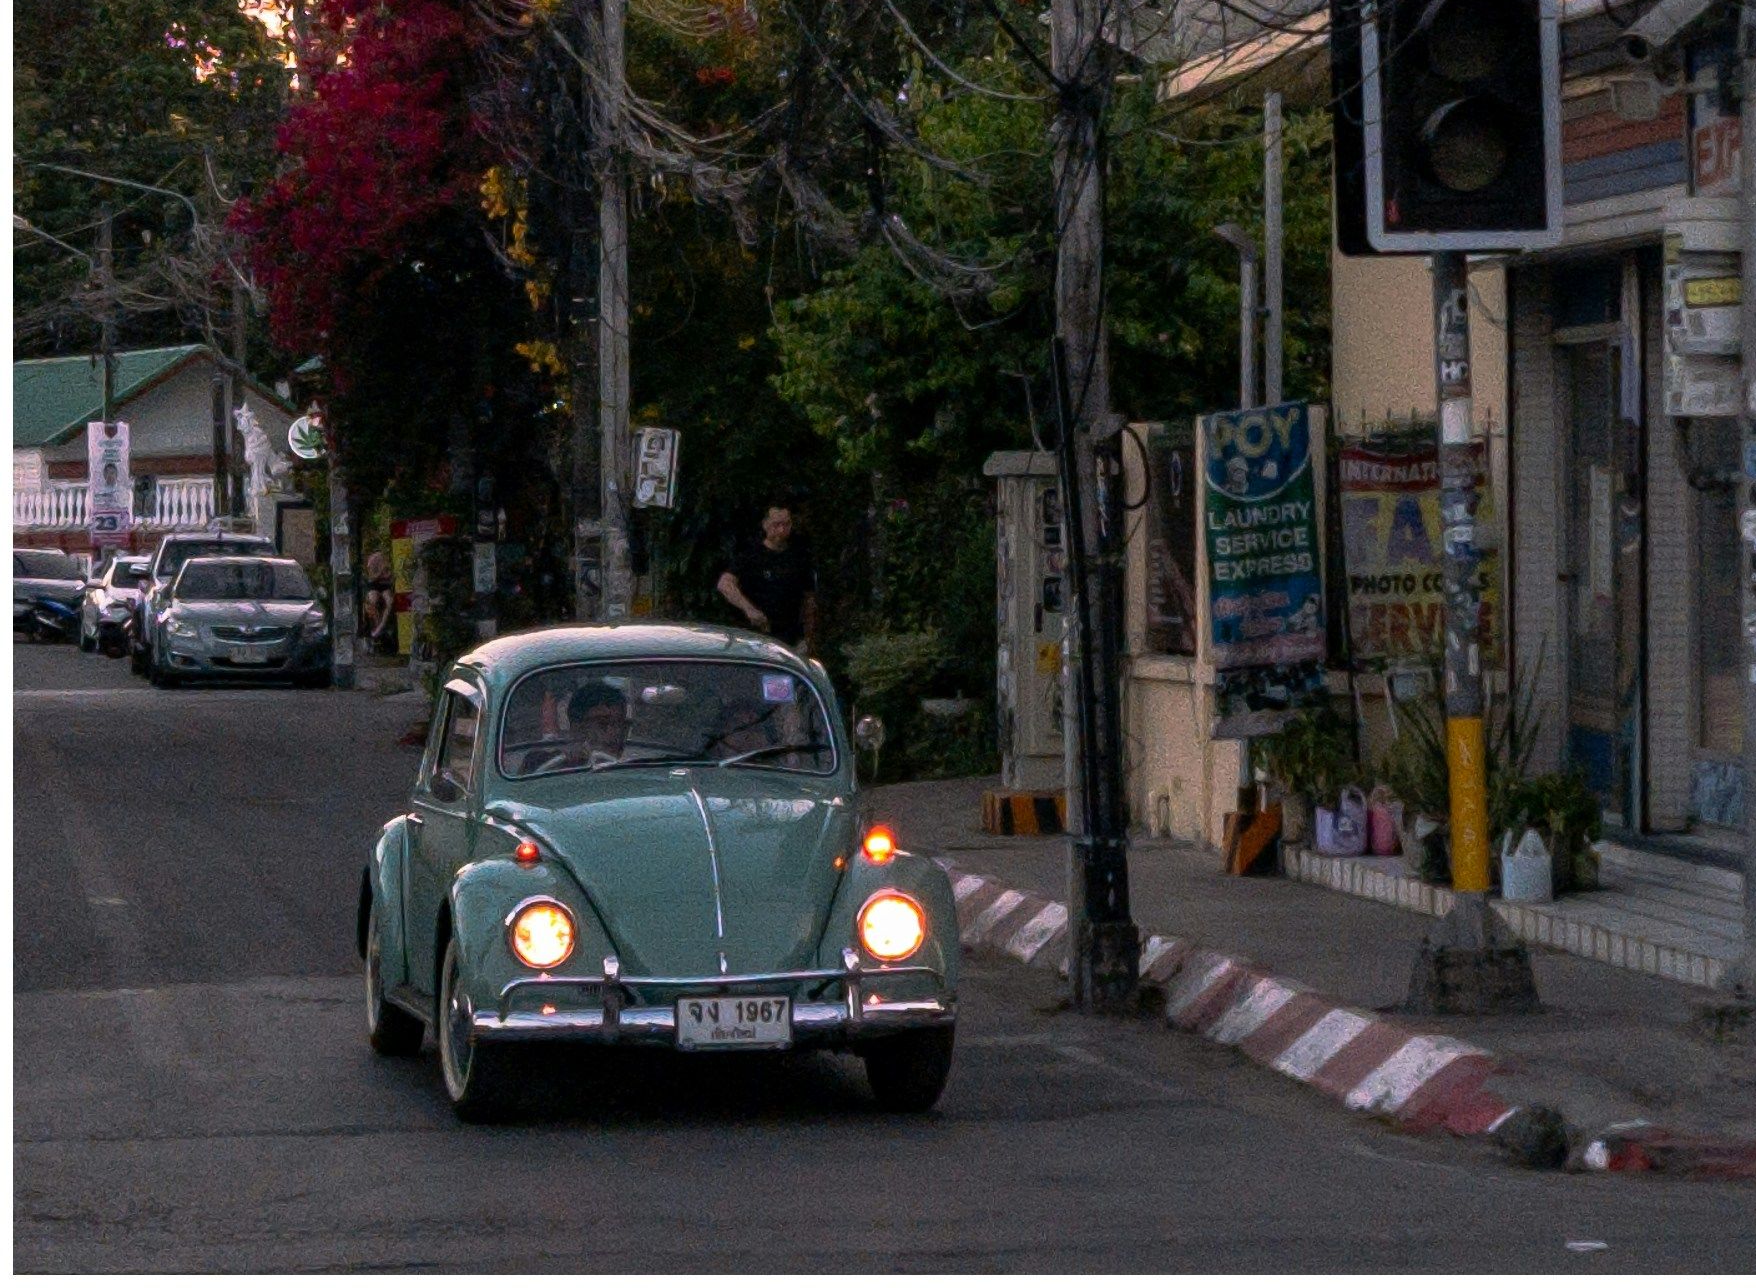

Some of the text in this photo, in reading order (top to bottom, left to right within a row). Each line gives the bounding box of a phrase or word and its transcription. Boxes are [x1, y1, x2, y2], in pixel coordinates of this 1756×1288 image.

[1210, 407, 1300, 459] POY
[1208, 500, 1311, 530] LAUNDRY
[1213, 526, 1310, 556] SERVICE
[1213, 552, 1314, 582] EXPRESS
[1350, 574, 1417, 595] PHOTO
[736, 1000, 786, 1023] 1967
